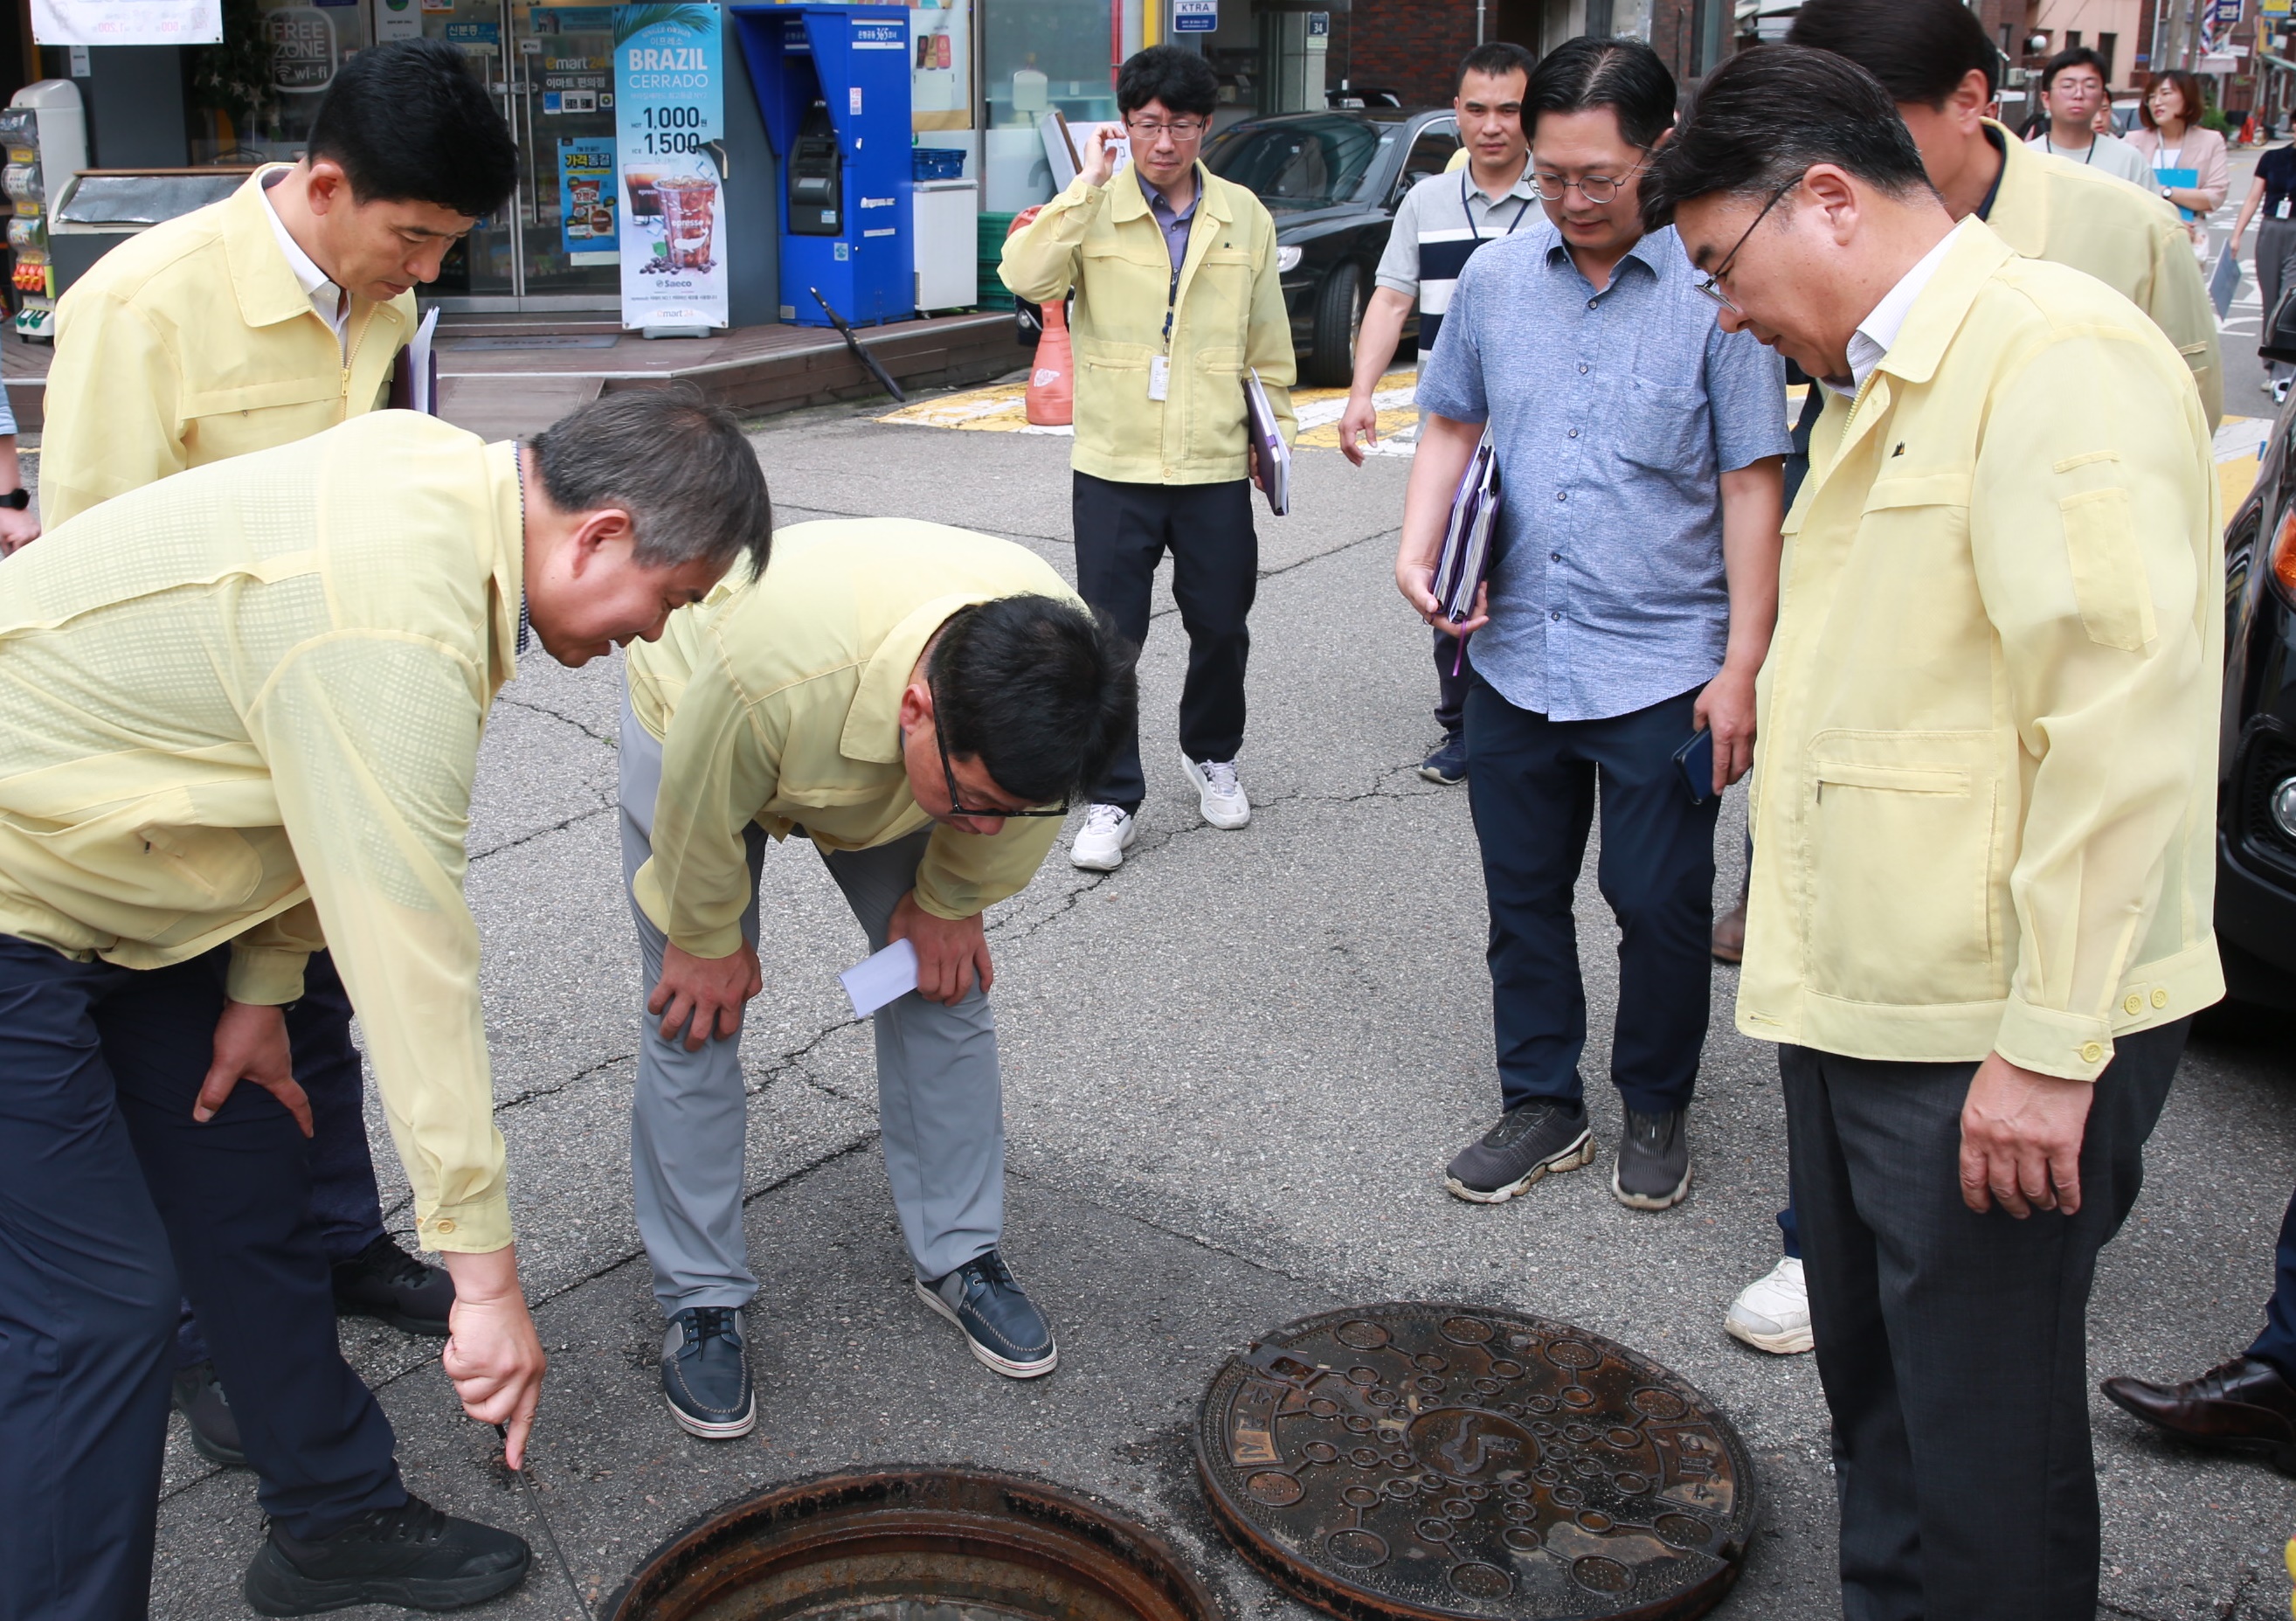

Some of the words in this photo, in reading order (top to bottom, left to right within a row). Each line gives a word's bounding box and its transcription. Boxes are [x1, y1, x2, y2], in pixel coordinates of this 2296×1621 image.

[1181, 3, 1210, 12] KTRA
[273, 22, 325, 38] FREE
[667, 26, 692, 38] ORIGIN
[1313, 22, 1324, 34] 34
[650, 37, 683, 45] 이프레소
[273, 40, 325, 58] ZONE
[629, 48, 708, 71] BRAZIL
[294, 66, 328, 80] wi-fi
[546, 77, 575, 88] 이마트
[577, 77, 605, 88] 편의점
[629, 73, 709, 88] CERRADO
[643, 107, 699, 129] 1,000
[701, 119, 708, 128] 원
[644, 132, 700, 156] 1,500
[566, 155, 611, 168] 가격동결
[671, 219, 704, 229] epresso
